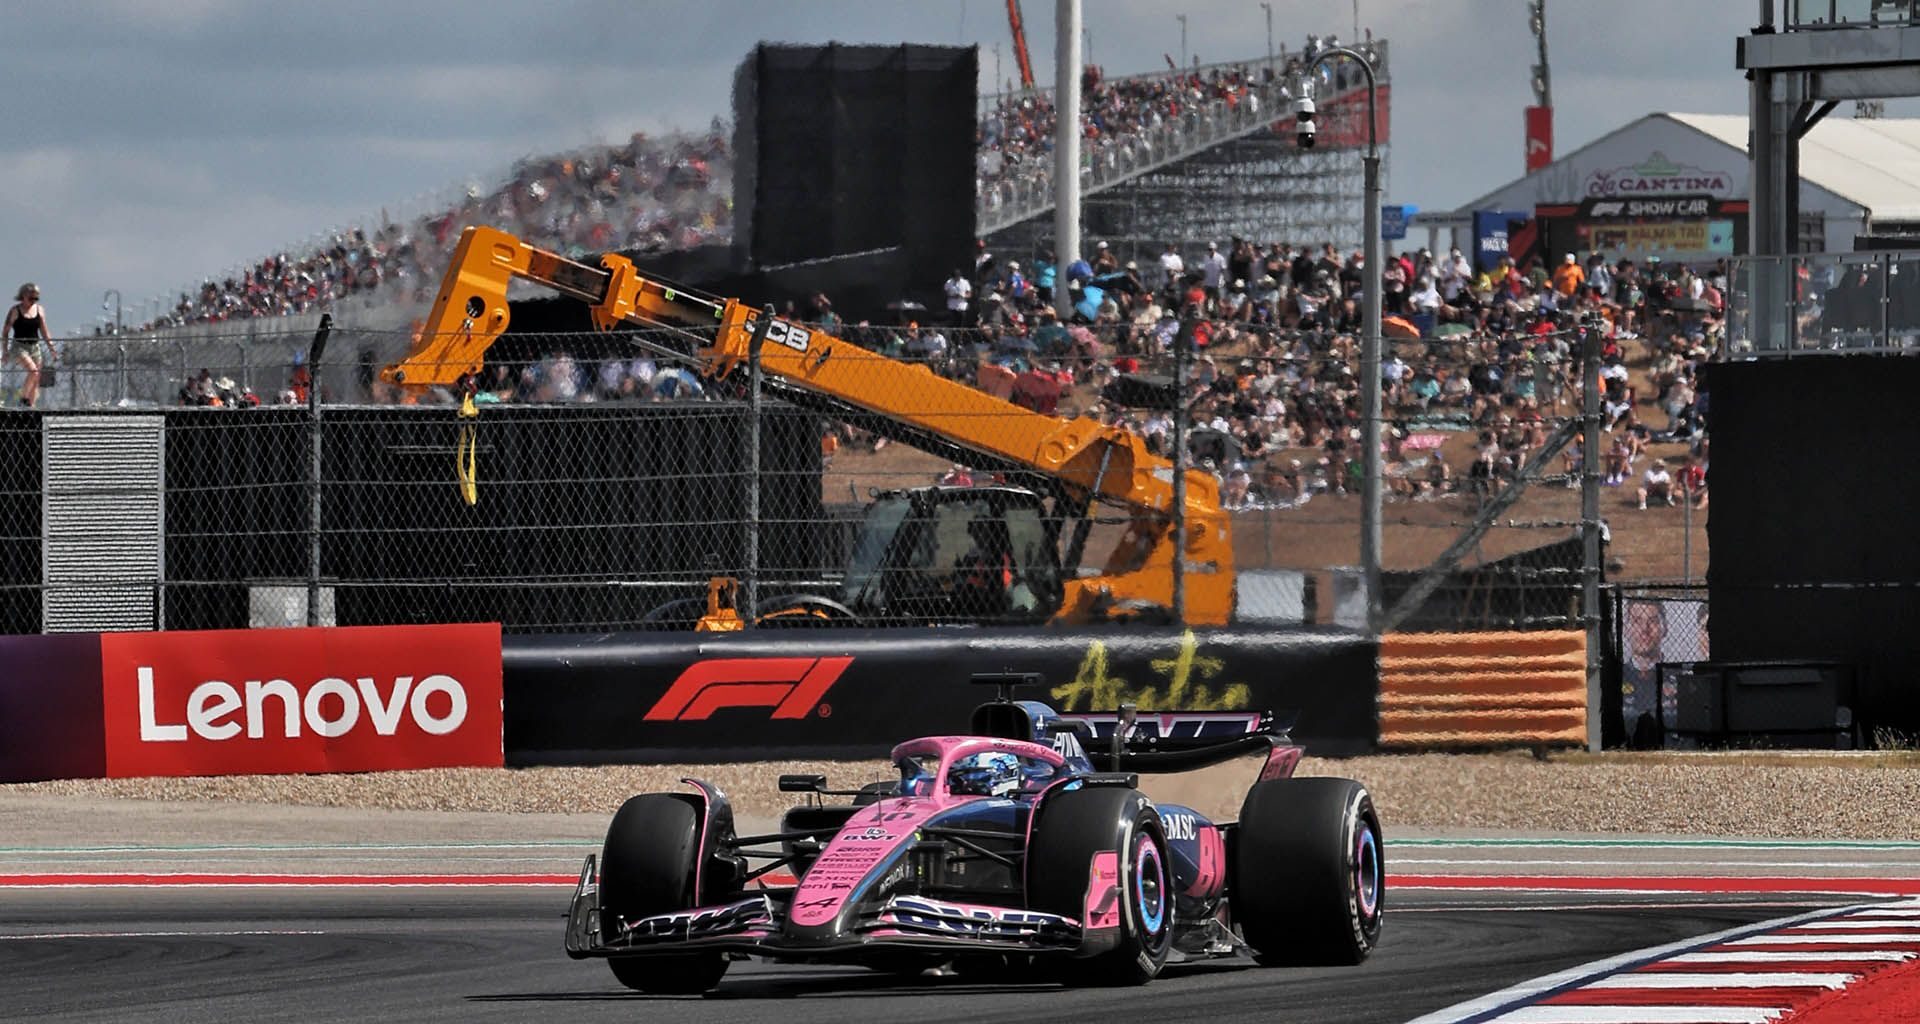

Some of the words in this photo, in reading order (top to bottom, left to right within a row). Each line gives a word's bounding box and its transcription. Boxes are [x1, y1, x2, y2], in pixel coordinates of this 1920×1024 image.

[1618, 176, 1725, 192] CANTINA
[1627, 201, 1675, 216] SHOW
[1677, 199, 1709, 215] CAR
[137, 666, 468, 741] Lenovo
[1167, 813, 1197, 841] MSC
[842, 834, 898, 842] BWT
